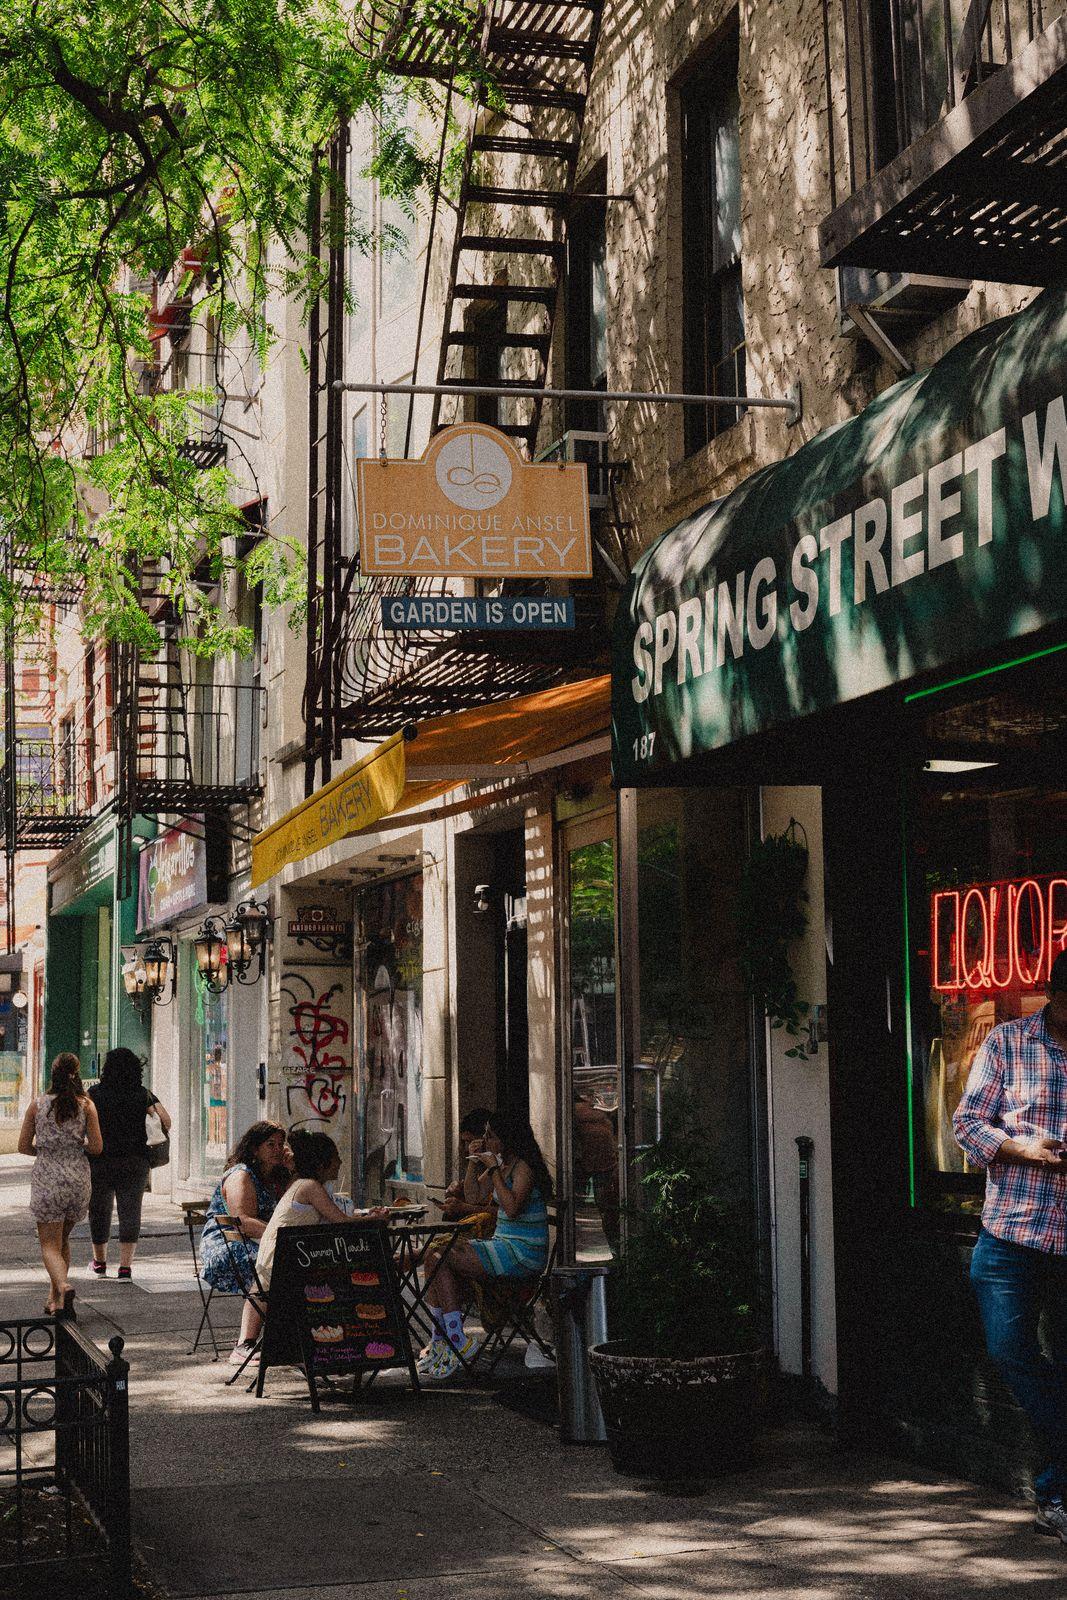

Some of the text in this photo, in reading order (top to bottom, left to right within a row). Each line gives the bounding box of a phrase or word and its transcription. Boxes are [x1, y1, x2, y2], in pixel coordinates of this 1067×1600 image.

[373, 512, 578, 532] DOMINIQUE ANSEL
[374, 534, 578, 567] BAKERY
[631, 557, 777, 703] SPRING
[789, 426, 1006, 631] STREET
[390, 602, 567, 624] GARDEN IS OPEN
[632, 731, 656, 761] 187
[320, 776, 372, 838] BAKERY
